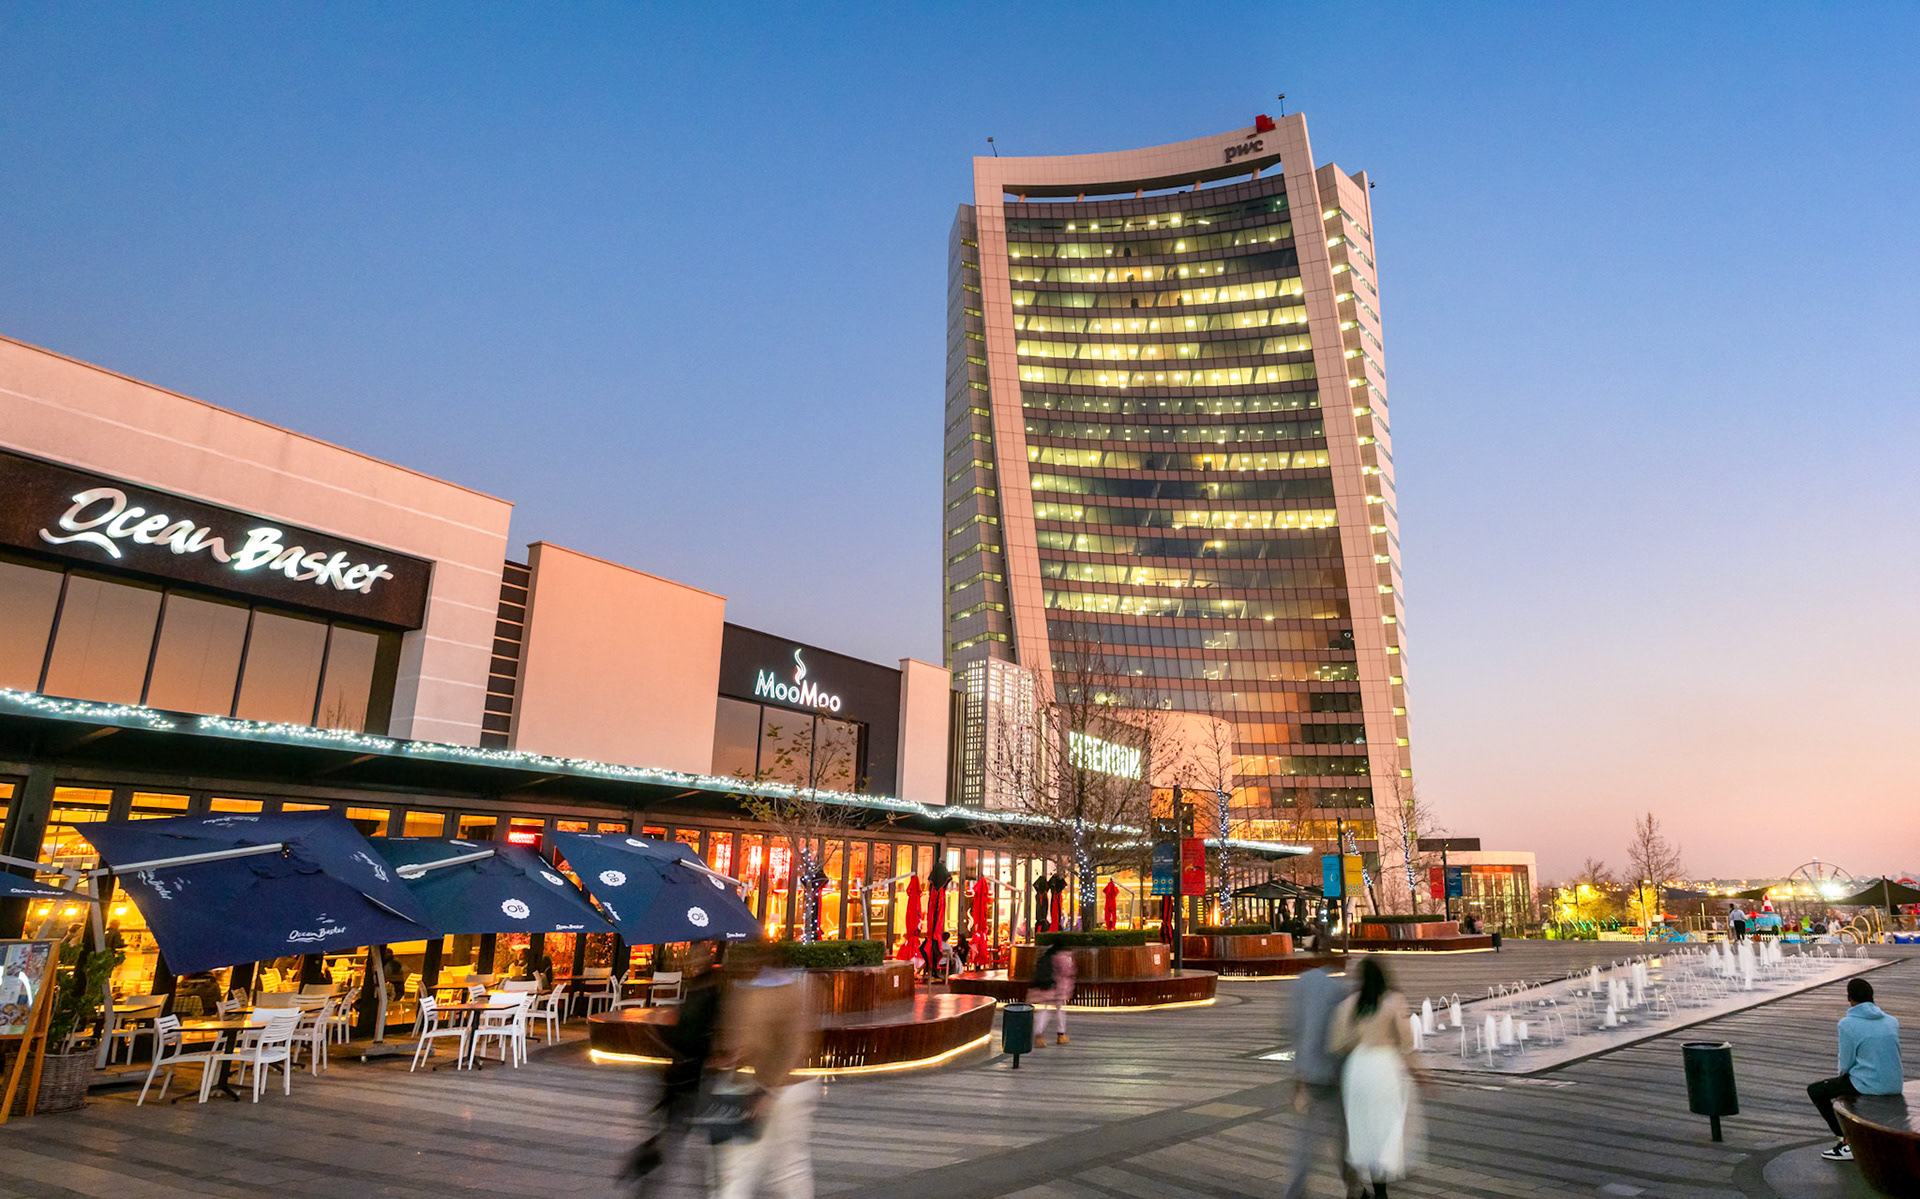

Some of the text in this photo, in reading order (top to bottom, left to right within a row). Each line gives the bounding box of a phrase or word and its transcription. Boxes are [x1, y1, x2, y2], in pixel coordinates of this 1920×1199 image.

[1224, 140, 1263, 163] pwc
[39, 487, 394, 593] Ocean Basket
[755, 669, 841, 712] MooMoo
